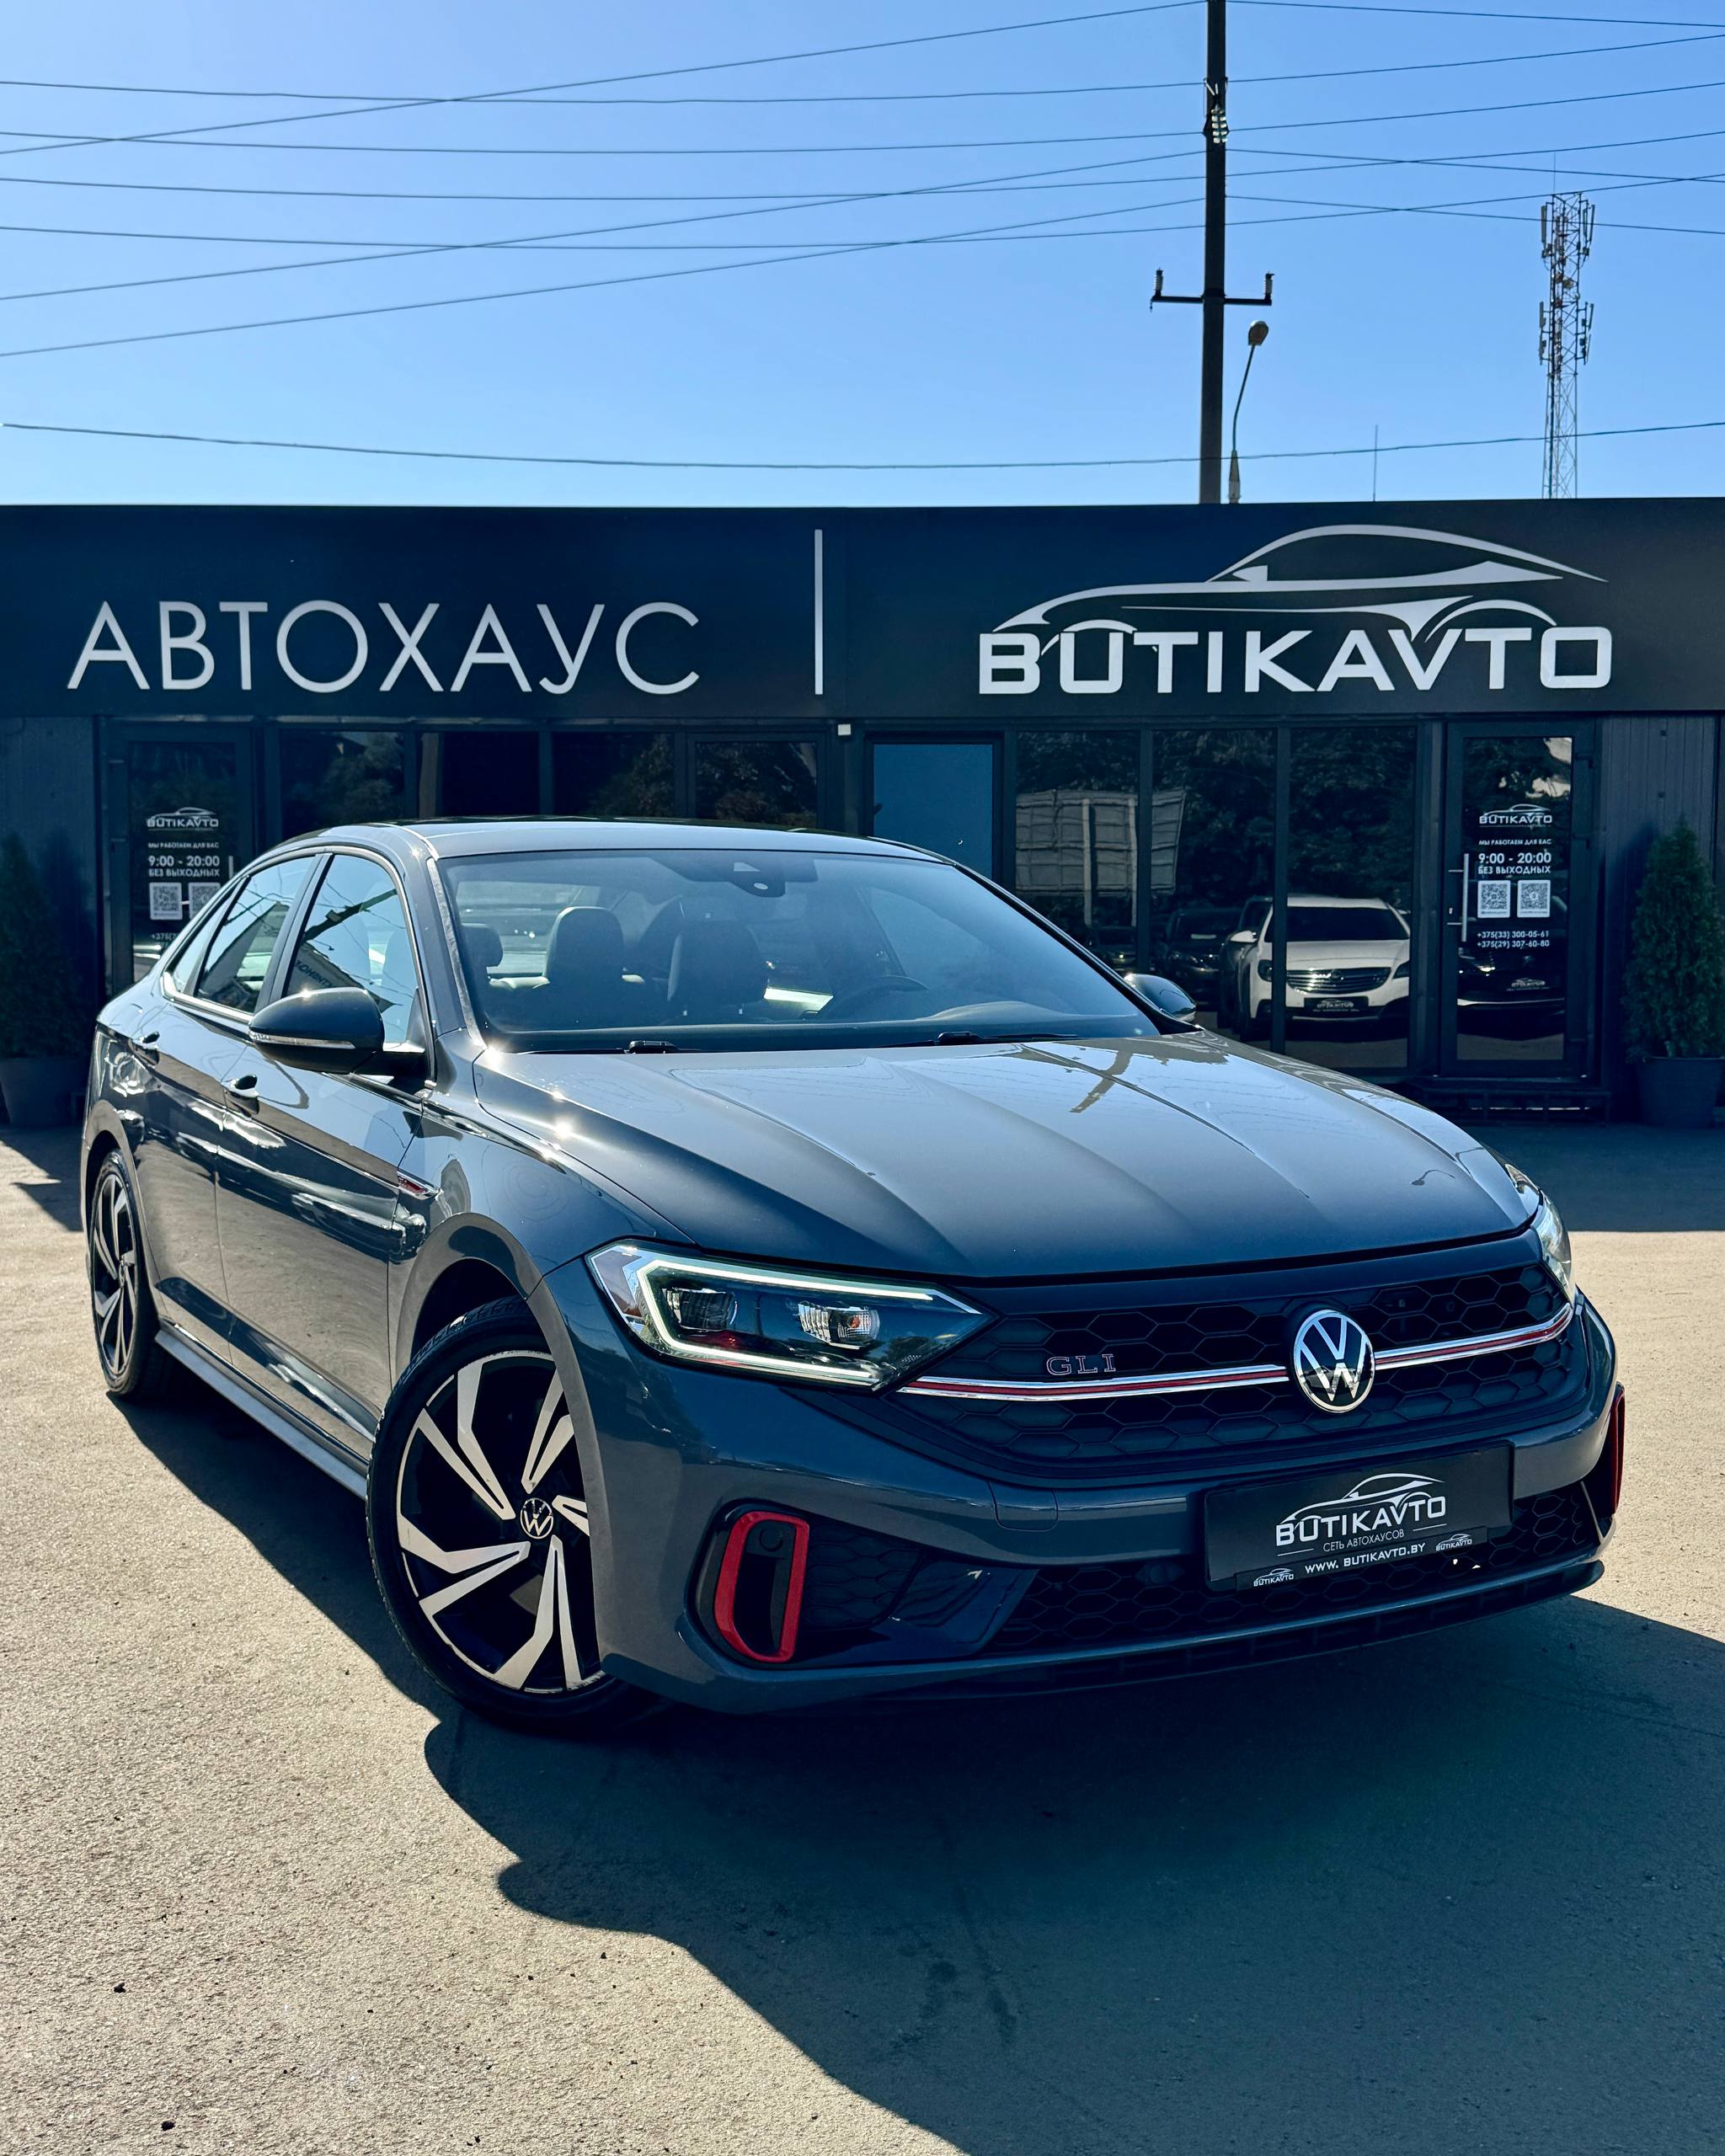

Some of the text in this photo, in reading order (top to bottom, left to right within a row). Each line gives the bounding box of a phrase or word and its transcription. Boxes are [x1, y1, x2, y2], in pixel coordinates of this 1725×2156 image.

[67, 599, 699, 695] АВТОХАУС
[979, 626, 1612, 695] BUTIKAVTO
[147, 818, 219, 828] BUTIKAVTO
[1479, 814, 1552, 825] BUTIKAVTO
[148, 856, 174, 867] 9:00
[186, 856, 220, 867] 20:00
[1478, 853, 1504, 864] 9:00
[1517, 852, 1551, 863] 20:00
[148, 868, 220, 877] БЕЗ ВЫХОДНЫХ
[1478, 866, 1551, 874] БЕЗ ВЫХОДНЫХ
[1477, 931, 1509, 939] +375(33)
[1477, 940, 1509, 949] +375(29)
[1046, 1353, 1116, 1376] GLI
[1275, 1496, 1446, 1546] BUTIKAVTO
[1323, 1529, 1405, 1552] СЕТЬ АВТОХАУСОВ
[1436, 1539, 1472, 1551] BUTIKAVTO
[1343, 1543, 1426, 1567] BUTIKAVTO.BY
[1253, 1573, 1295, 1588] BUTIKAVTO
